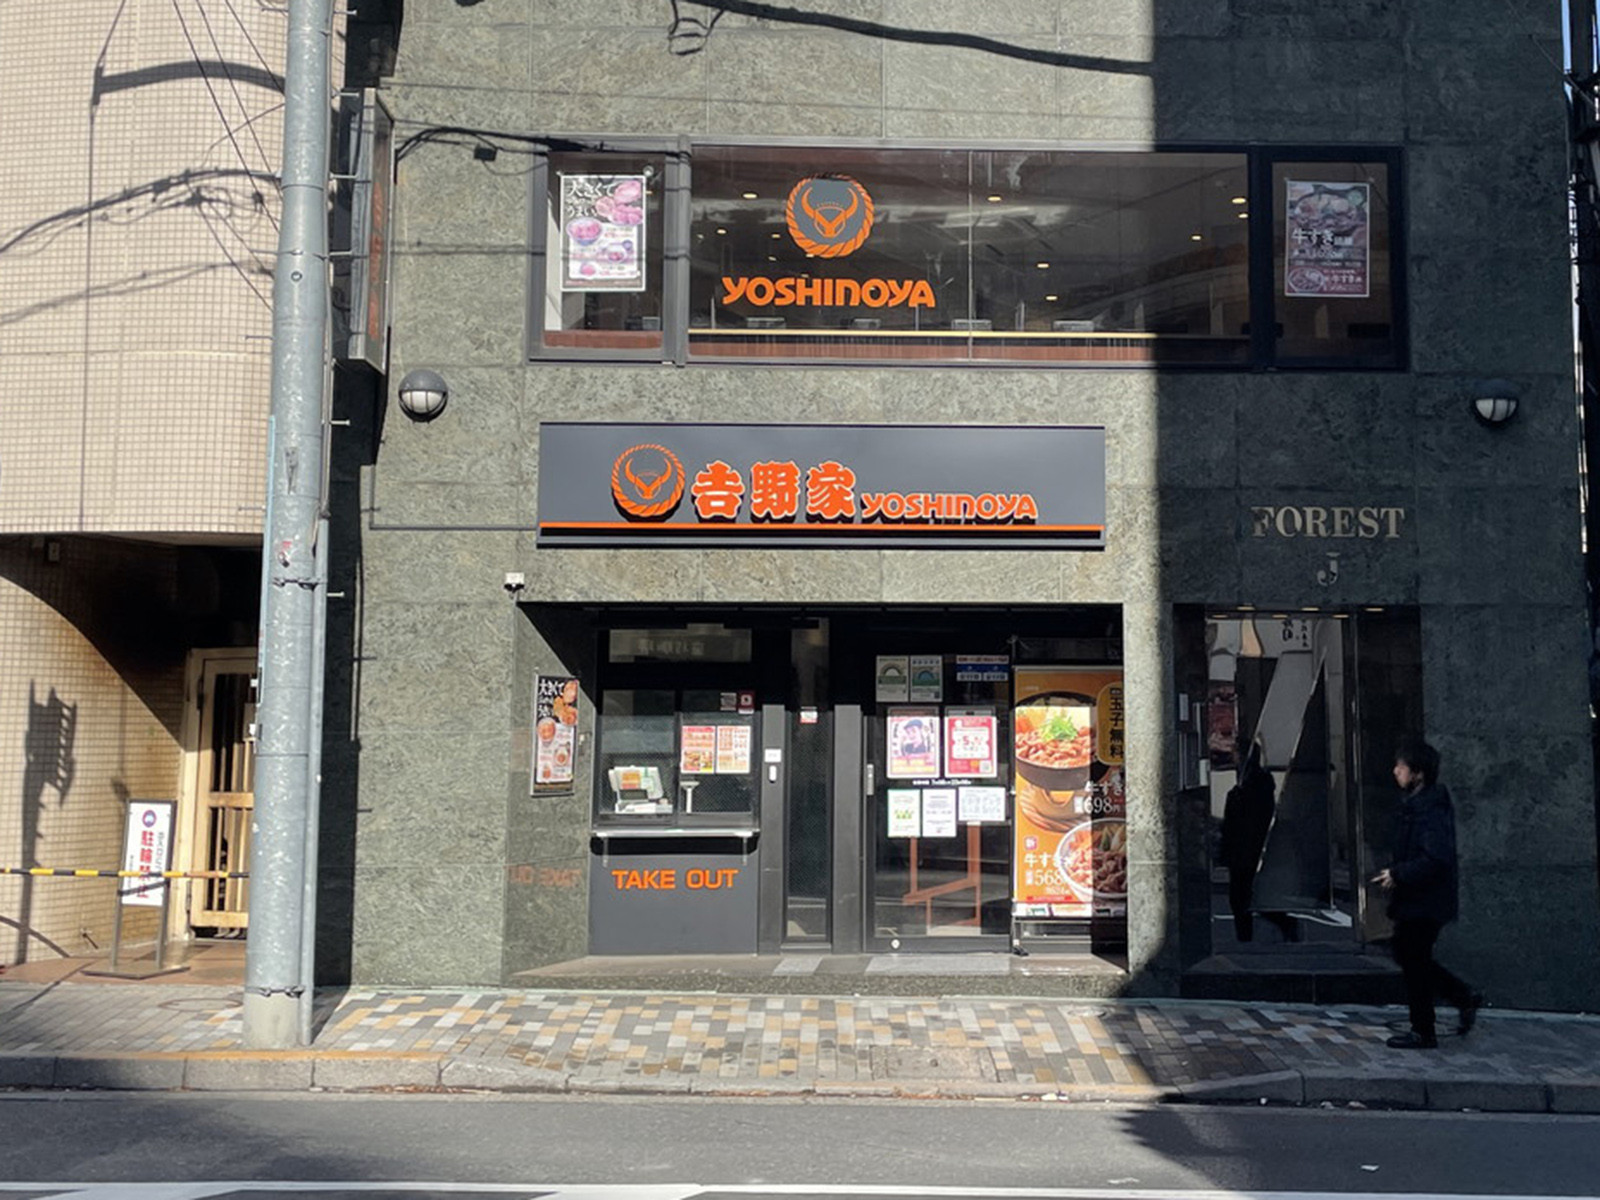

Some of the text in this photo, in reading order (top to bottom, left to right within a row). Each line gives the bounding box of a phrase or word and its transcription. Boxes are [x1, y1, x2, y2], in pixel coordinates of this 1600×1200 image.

[721, 276, 936, 308] YOSHINOYA
[691, 460, 1039, 519] 吉野家 YOSHINOYA
[1251, 505, 1405, 538] FOREST
[1316, 551, 1341, 586] J
[612, 868, 739, 889] TAKE OUT
